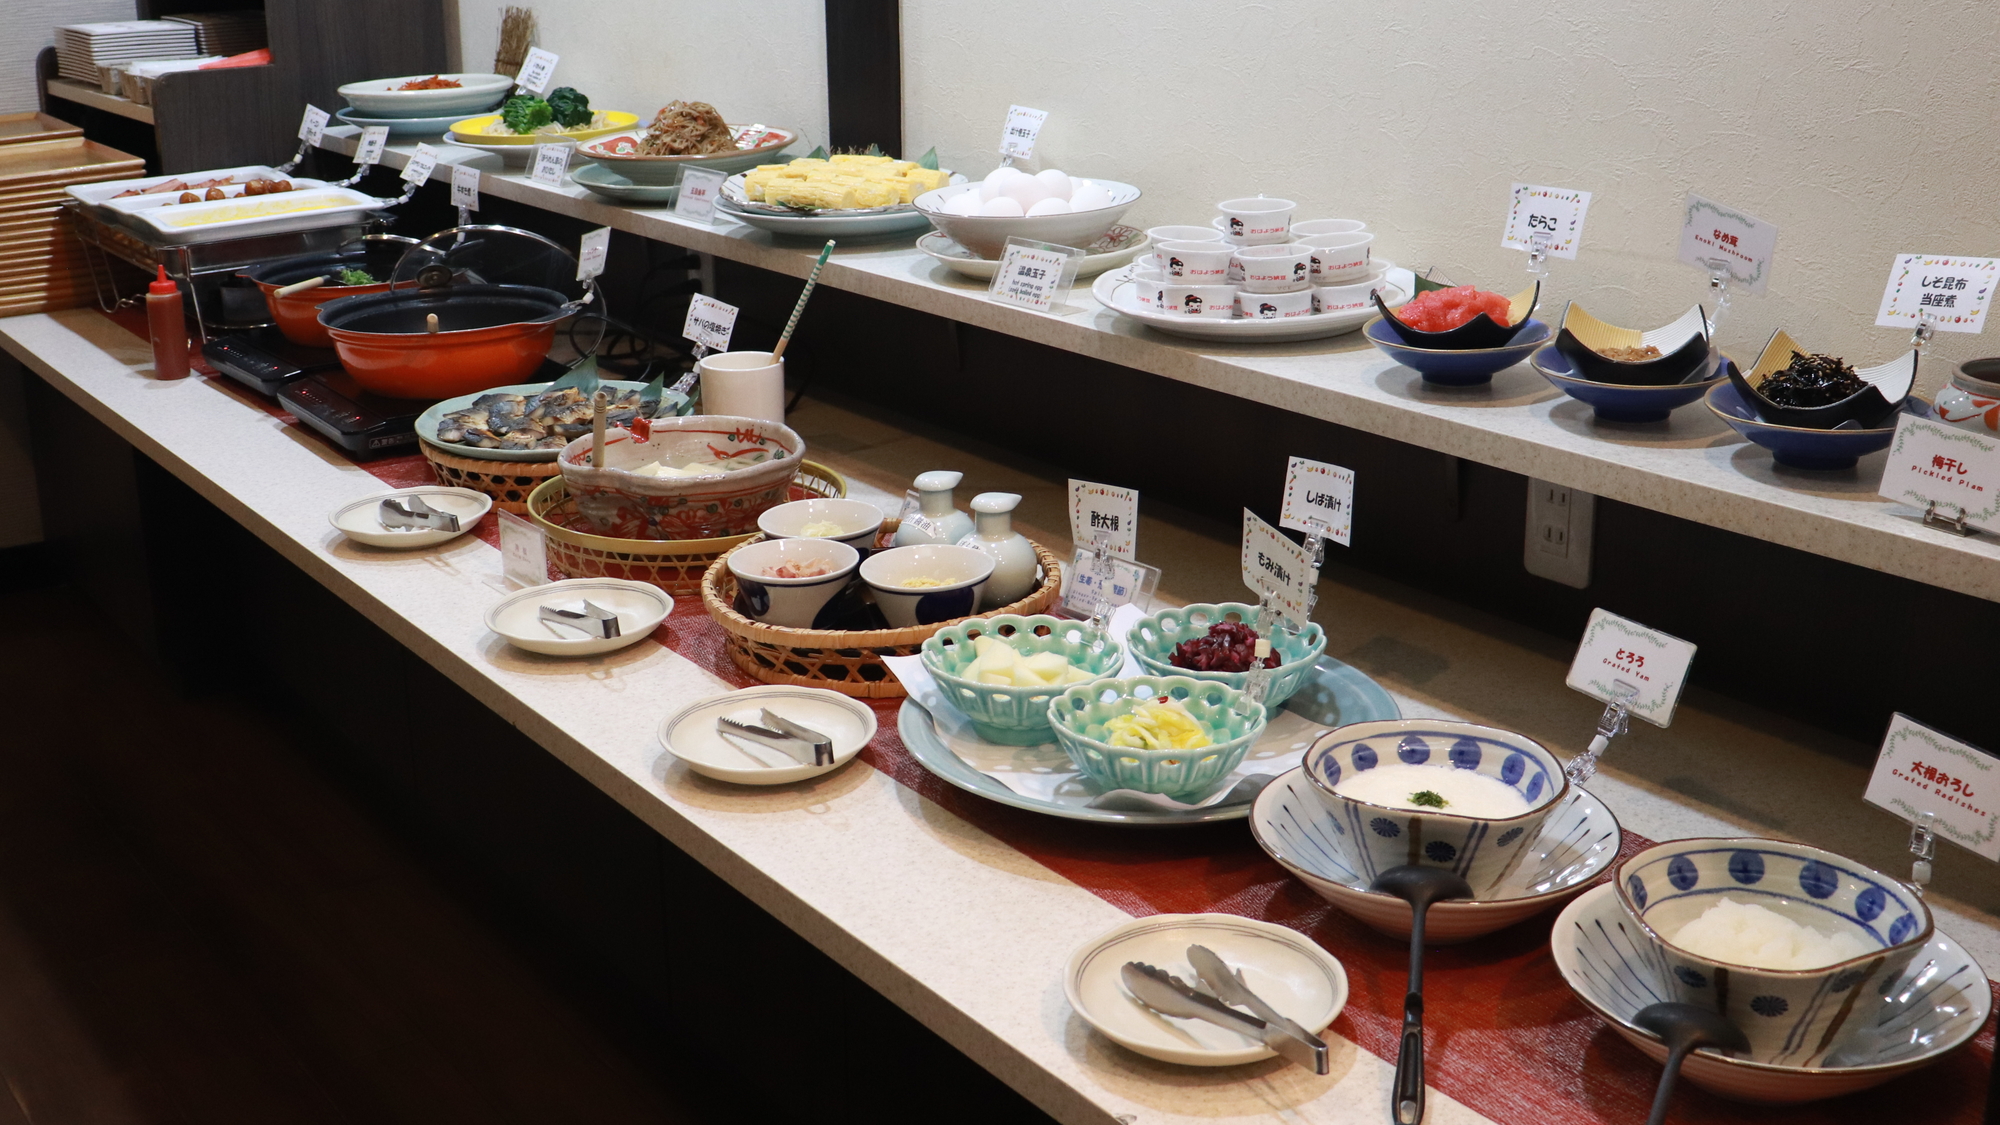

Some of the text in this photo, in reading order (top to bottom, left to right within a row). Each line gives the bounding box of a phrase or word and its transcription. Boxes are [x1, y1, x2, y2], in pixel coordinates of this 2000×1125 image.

[1528, 213, 1557, 231] たらこ
[1713, 229, 1739, 247] なめ茸
[1719, 244, 1753, 263] Mushroom
[1018, 265, 1046, 280] 温泉玉子
[1019, 288, 1032, 296] boiled
[1020, 281, 1034, 290] spring
[1921, 275, 1969, 291] しそ昆布
[1920, 292, 1958, 308] 当座煮
[694, 317, 729, 335] サバの塩焼き
[1932, 454, 1968, 475] 梅干し
[1911, 465, 1953, 483] Pickled
[1306, 490, 1342, 513] しば漬け
[1090, 510, 1119, 532] 酢大根
[1257, 551, 1292, 587] もみ漬け
[1615, 648, 1645, 668] とろろ
[1602, 658, 1650, 682] Grated Yam
[1910, 760, 1975, 798] 大根おろし
[1892, 768, 1987, 817] Grated Radishes
